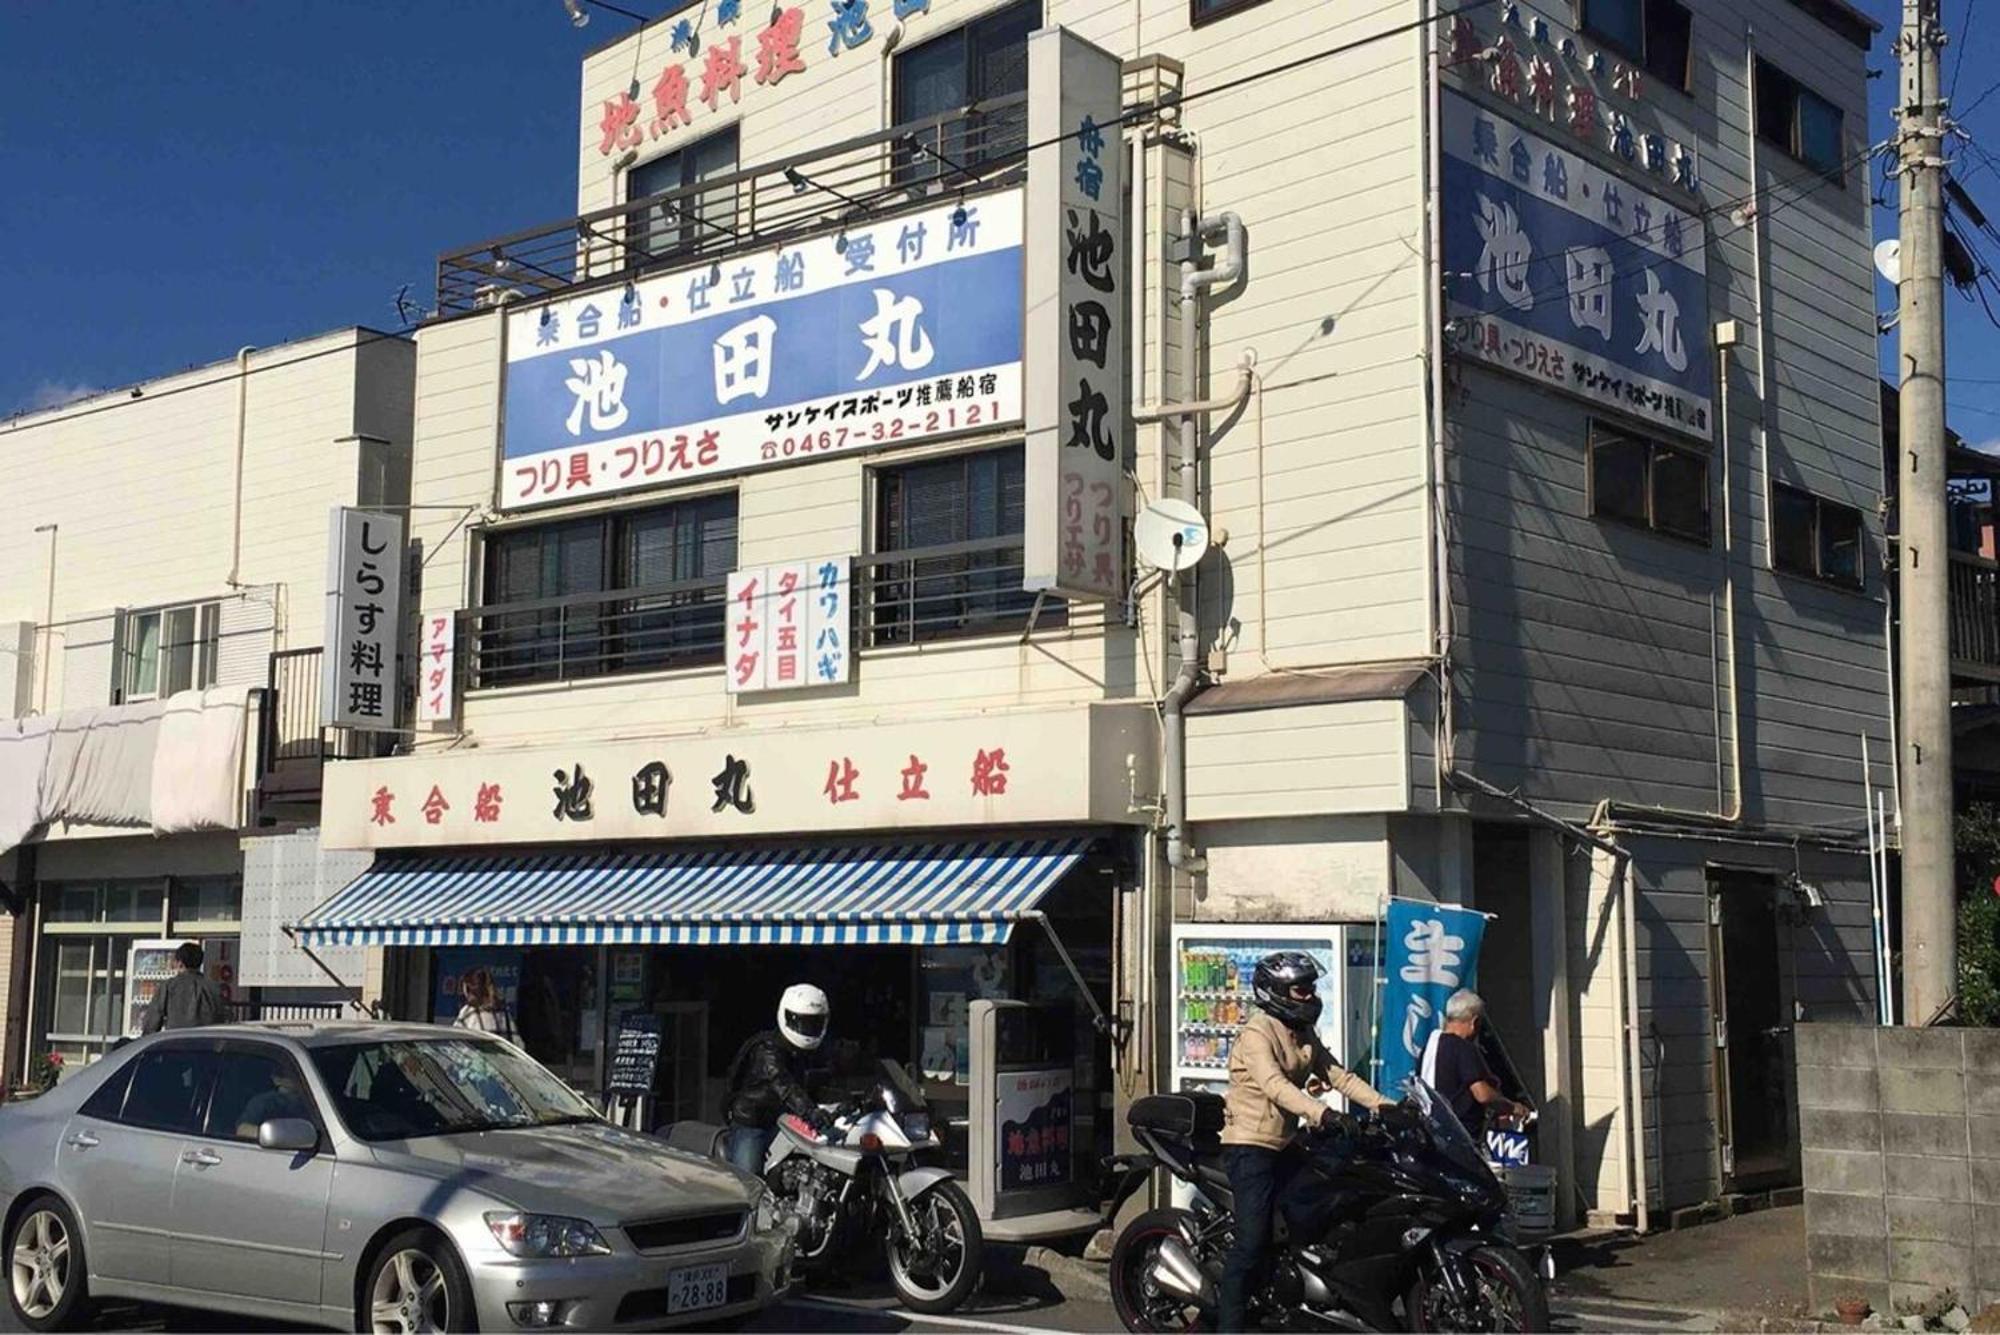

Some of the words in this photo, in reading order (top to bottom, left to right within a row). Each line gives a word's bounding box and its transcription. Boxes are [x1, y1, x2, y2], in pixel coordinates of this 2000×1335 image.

[599, 6, 806, 156] 地魚料理
[535, 256, 806, 348] 乗合船・仕立船
[844, 213, 981, 276] 受付所
[1066, 208, 1116, 462] 池田丸
[1472, 193, 1688, 373] 池田丸
[565, 288, 935, 436] 池田丸
[515, 430, 721, 498] つり具・つりえさ
[782, 401, 1000, 457] 0467-32-2121
[349, 521, 388, 717] しらす料理
[429, 618, 448, 715] アマダイ
[734, 578, 760, 685] イナダ
[777, 572, 798, 681] タイ五目
[816, 562, 842, 681] カワハギ
[370, 783, 504, 827] 乗合船
[552, 754, 757, 821] 池田丸
[823, 748, 1010, 804] 仕立船
